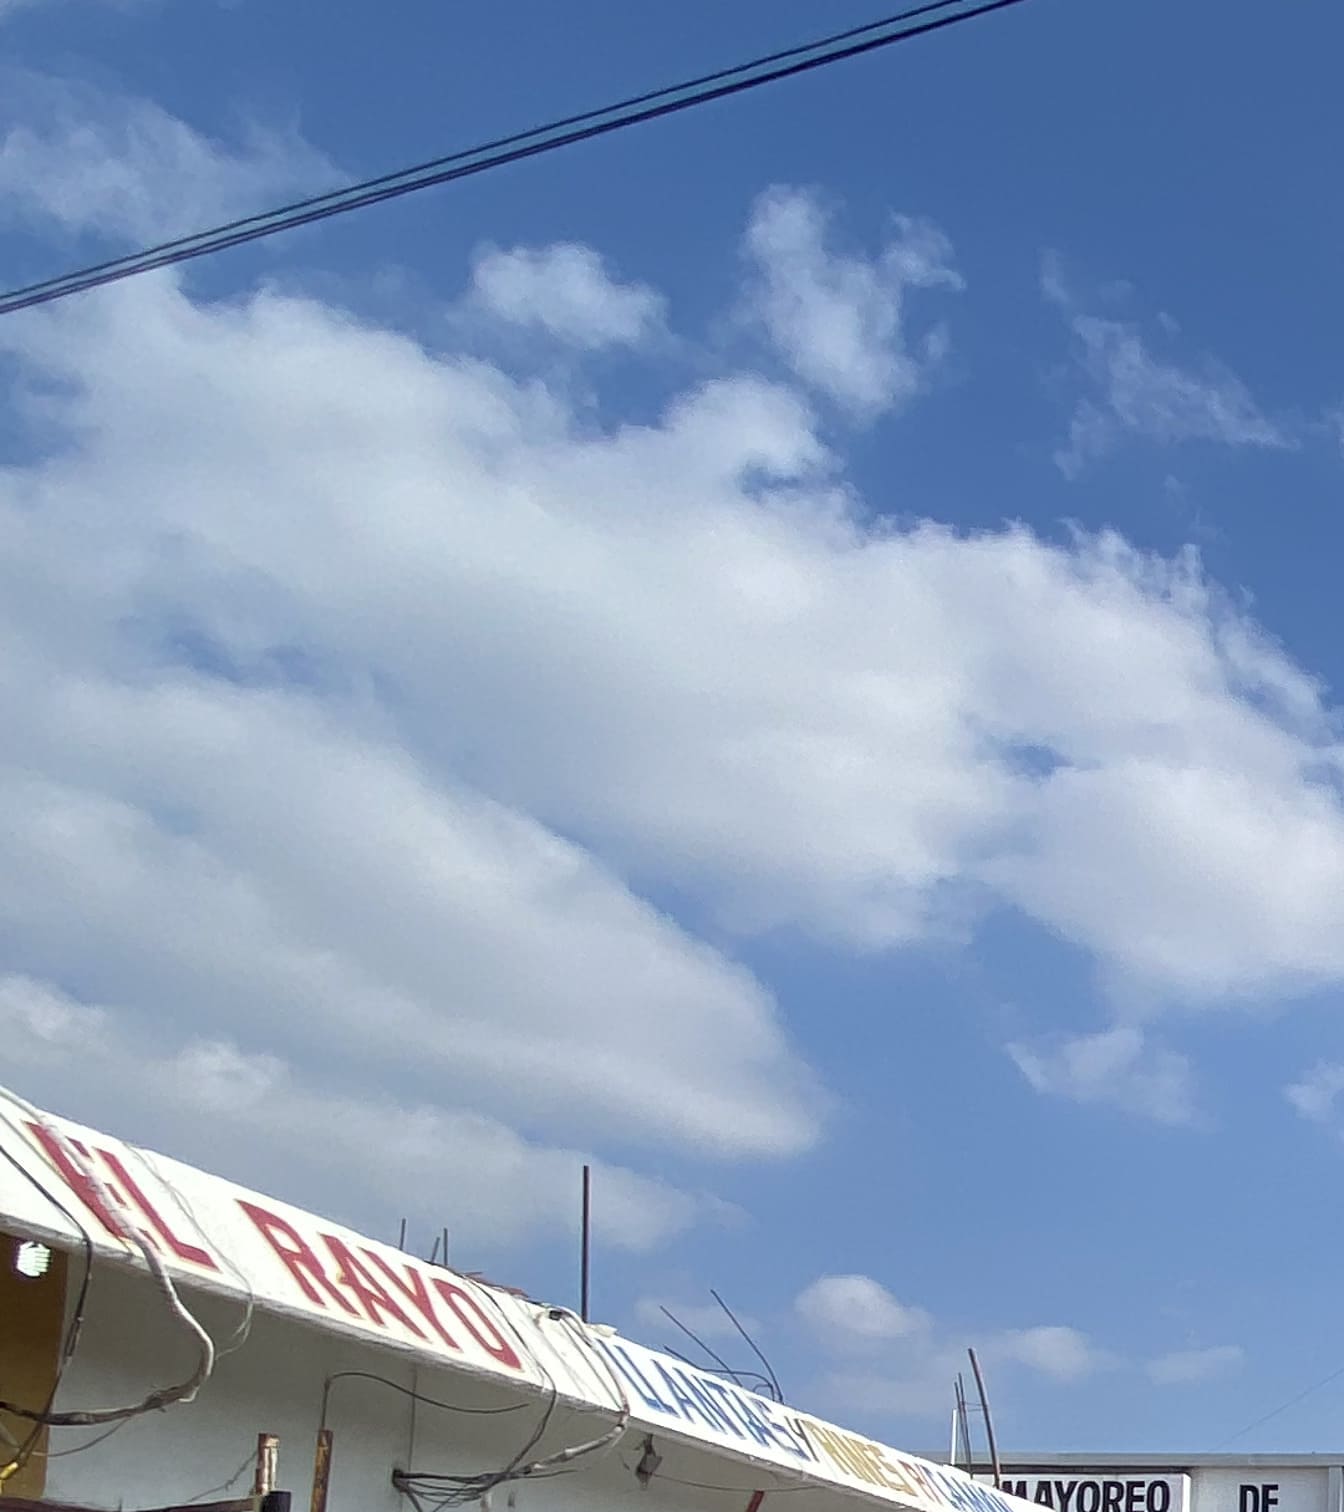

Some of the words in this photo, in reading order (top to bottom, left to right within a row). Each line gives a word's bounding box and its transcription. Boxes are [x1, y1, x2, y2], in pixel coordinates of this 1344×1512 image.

[22, 1120, 221, 1272] EL
[235, 1199, 523, 1370] RAYO
[594, 1338, 812, 1462] LLANTAS
[784, 1415, 820, 1463] Y
